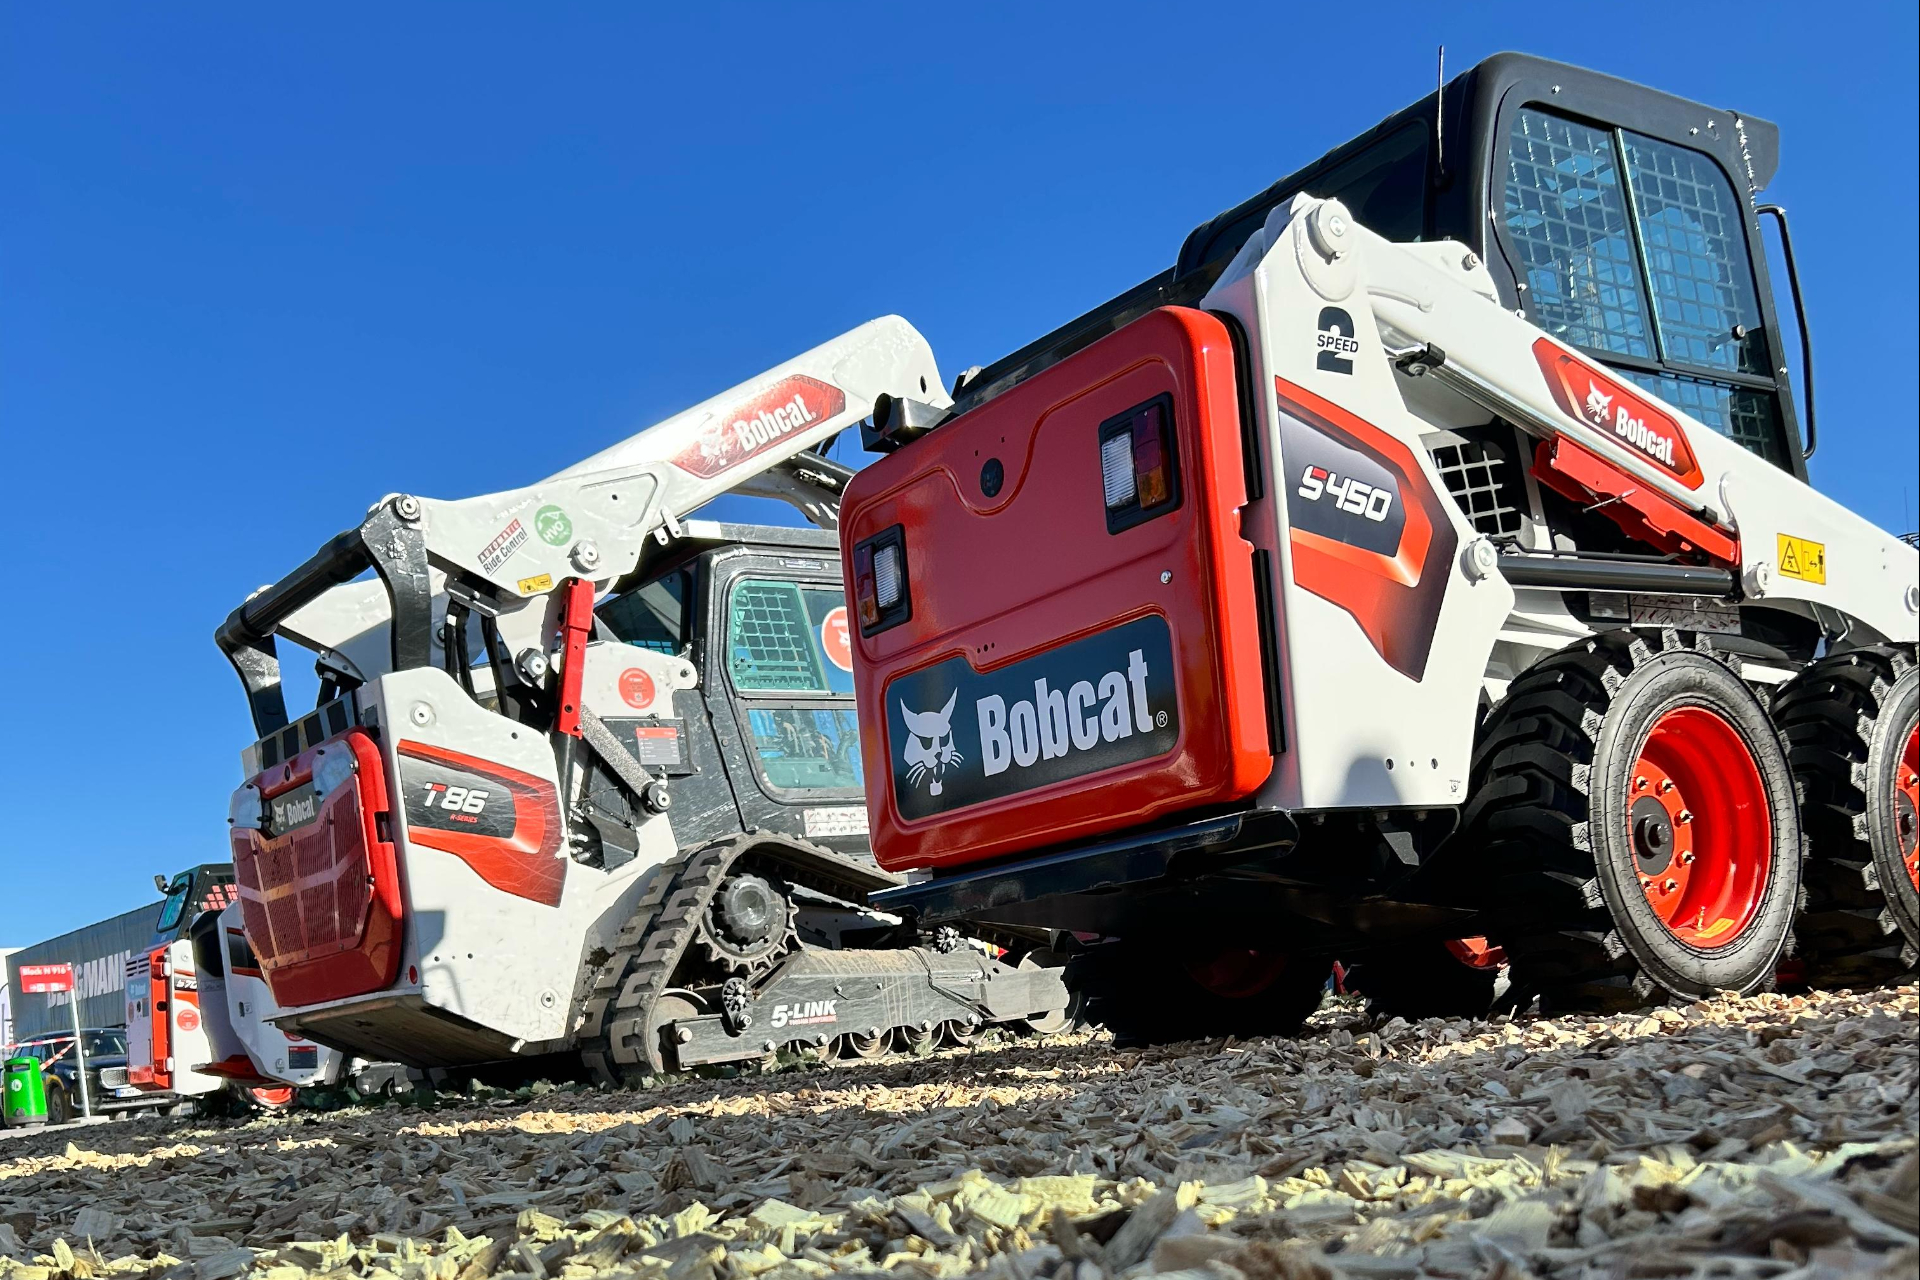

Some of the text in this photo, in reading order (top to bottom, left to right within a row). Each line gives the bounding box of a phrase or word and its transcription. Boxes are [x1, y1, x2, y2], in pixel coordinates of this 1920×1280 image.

[1317, 334, 1359, 353] SPEED
[733, 394, 814, 452] Bobcat
[1616, 405, 1674, 466] Bobcat
[1298, 465, 1393, 522] S450
[479, 519, 521, 563] AUTOMATIC
[483, 527, 528, 574] Ride Control
[543, 521, 565, 543] HVO
[976, 648, 1154, 777] Bobcat
[286, 795, 315, 826] Bobcat
[424, 782, 490, 814] T86
[770, 999, 838, 1028] 5-LINK
